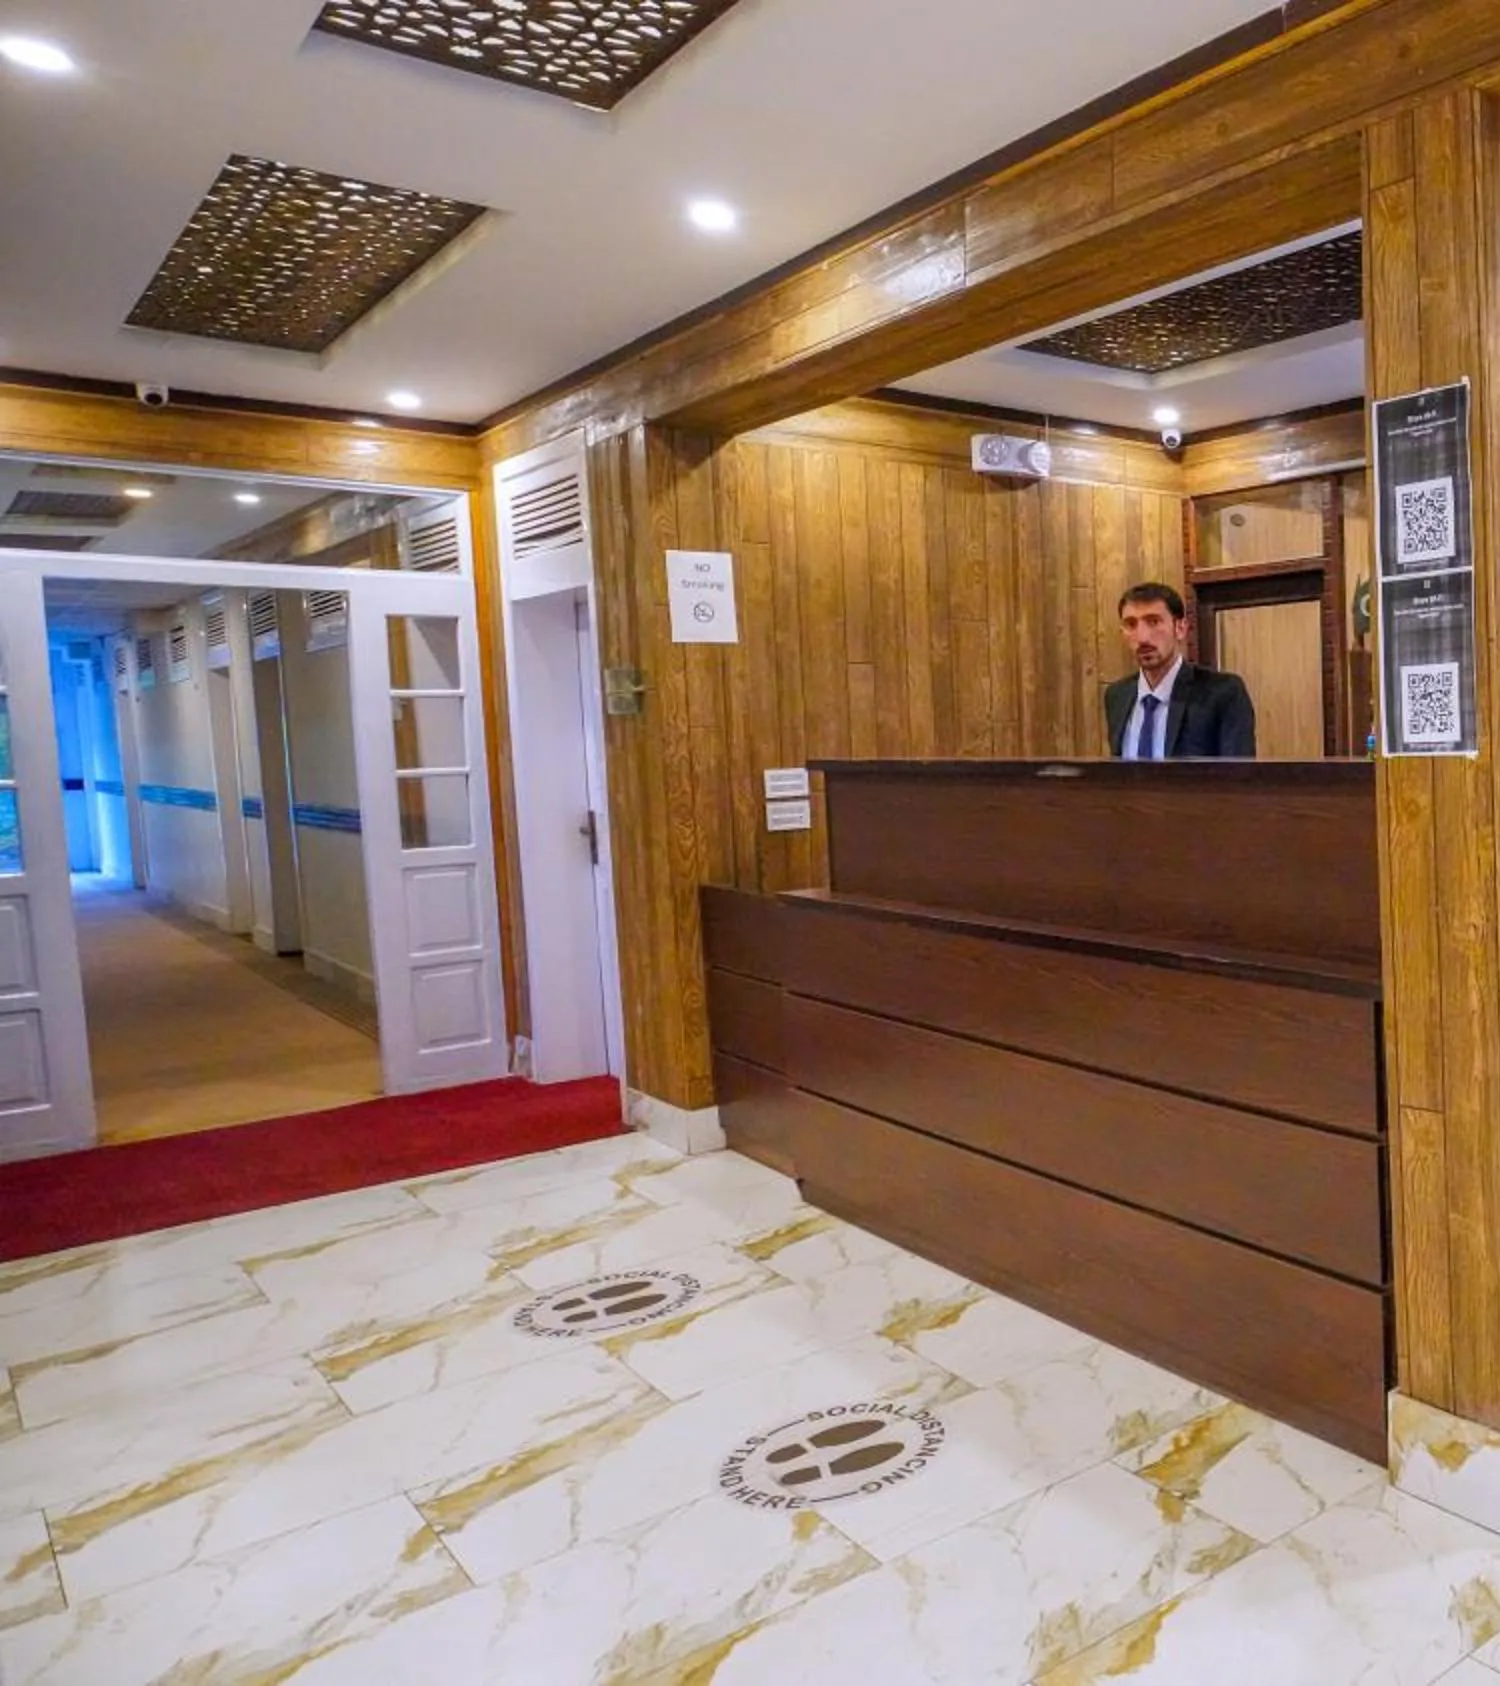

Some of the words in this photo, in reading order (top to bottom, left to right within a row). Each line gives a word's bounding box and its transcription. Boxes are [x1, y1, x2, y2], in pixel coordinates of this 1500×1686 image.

[694, 563, 711, 573] NO
[720, 1436, 768, 1488] STAND
[806, 1403, 909, 1422] SOCIAL
[859, 1409, 946, 1494] DISTANCING
[727, 1486, 808, 1510] HERE
